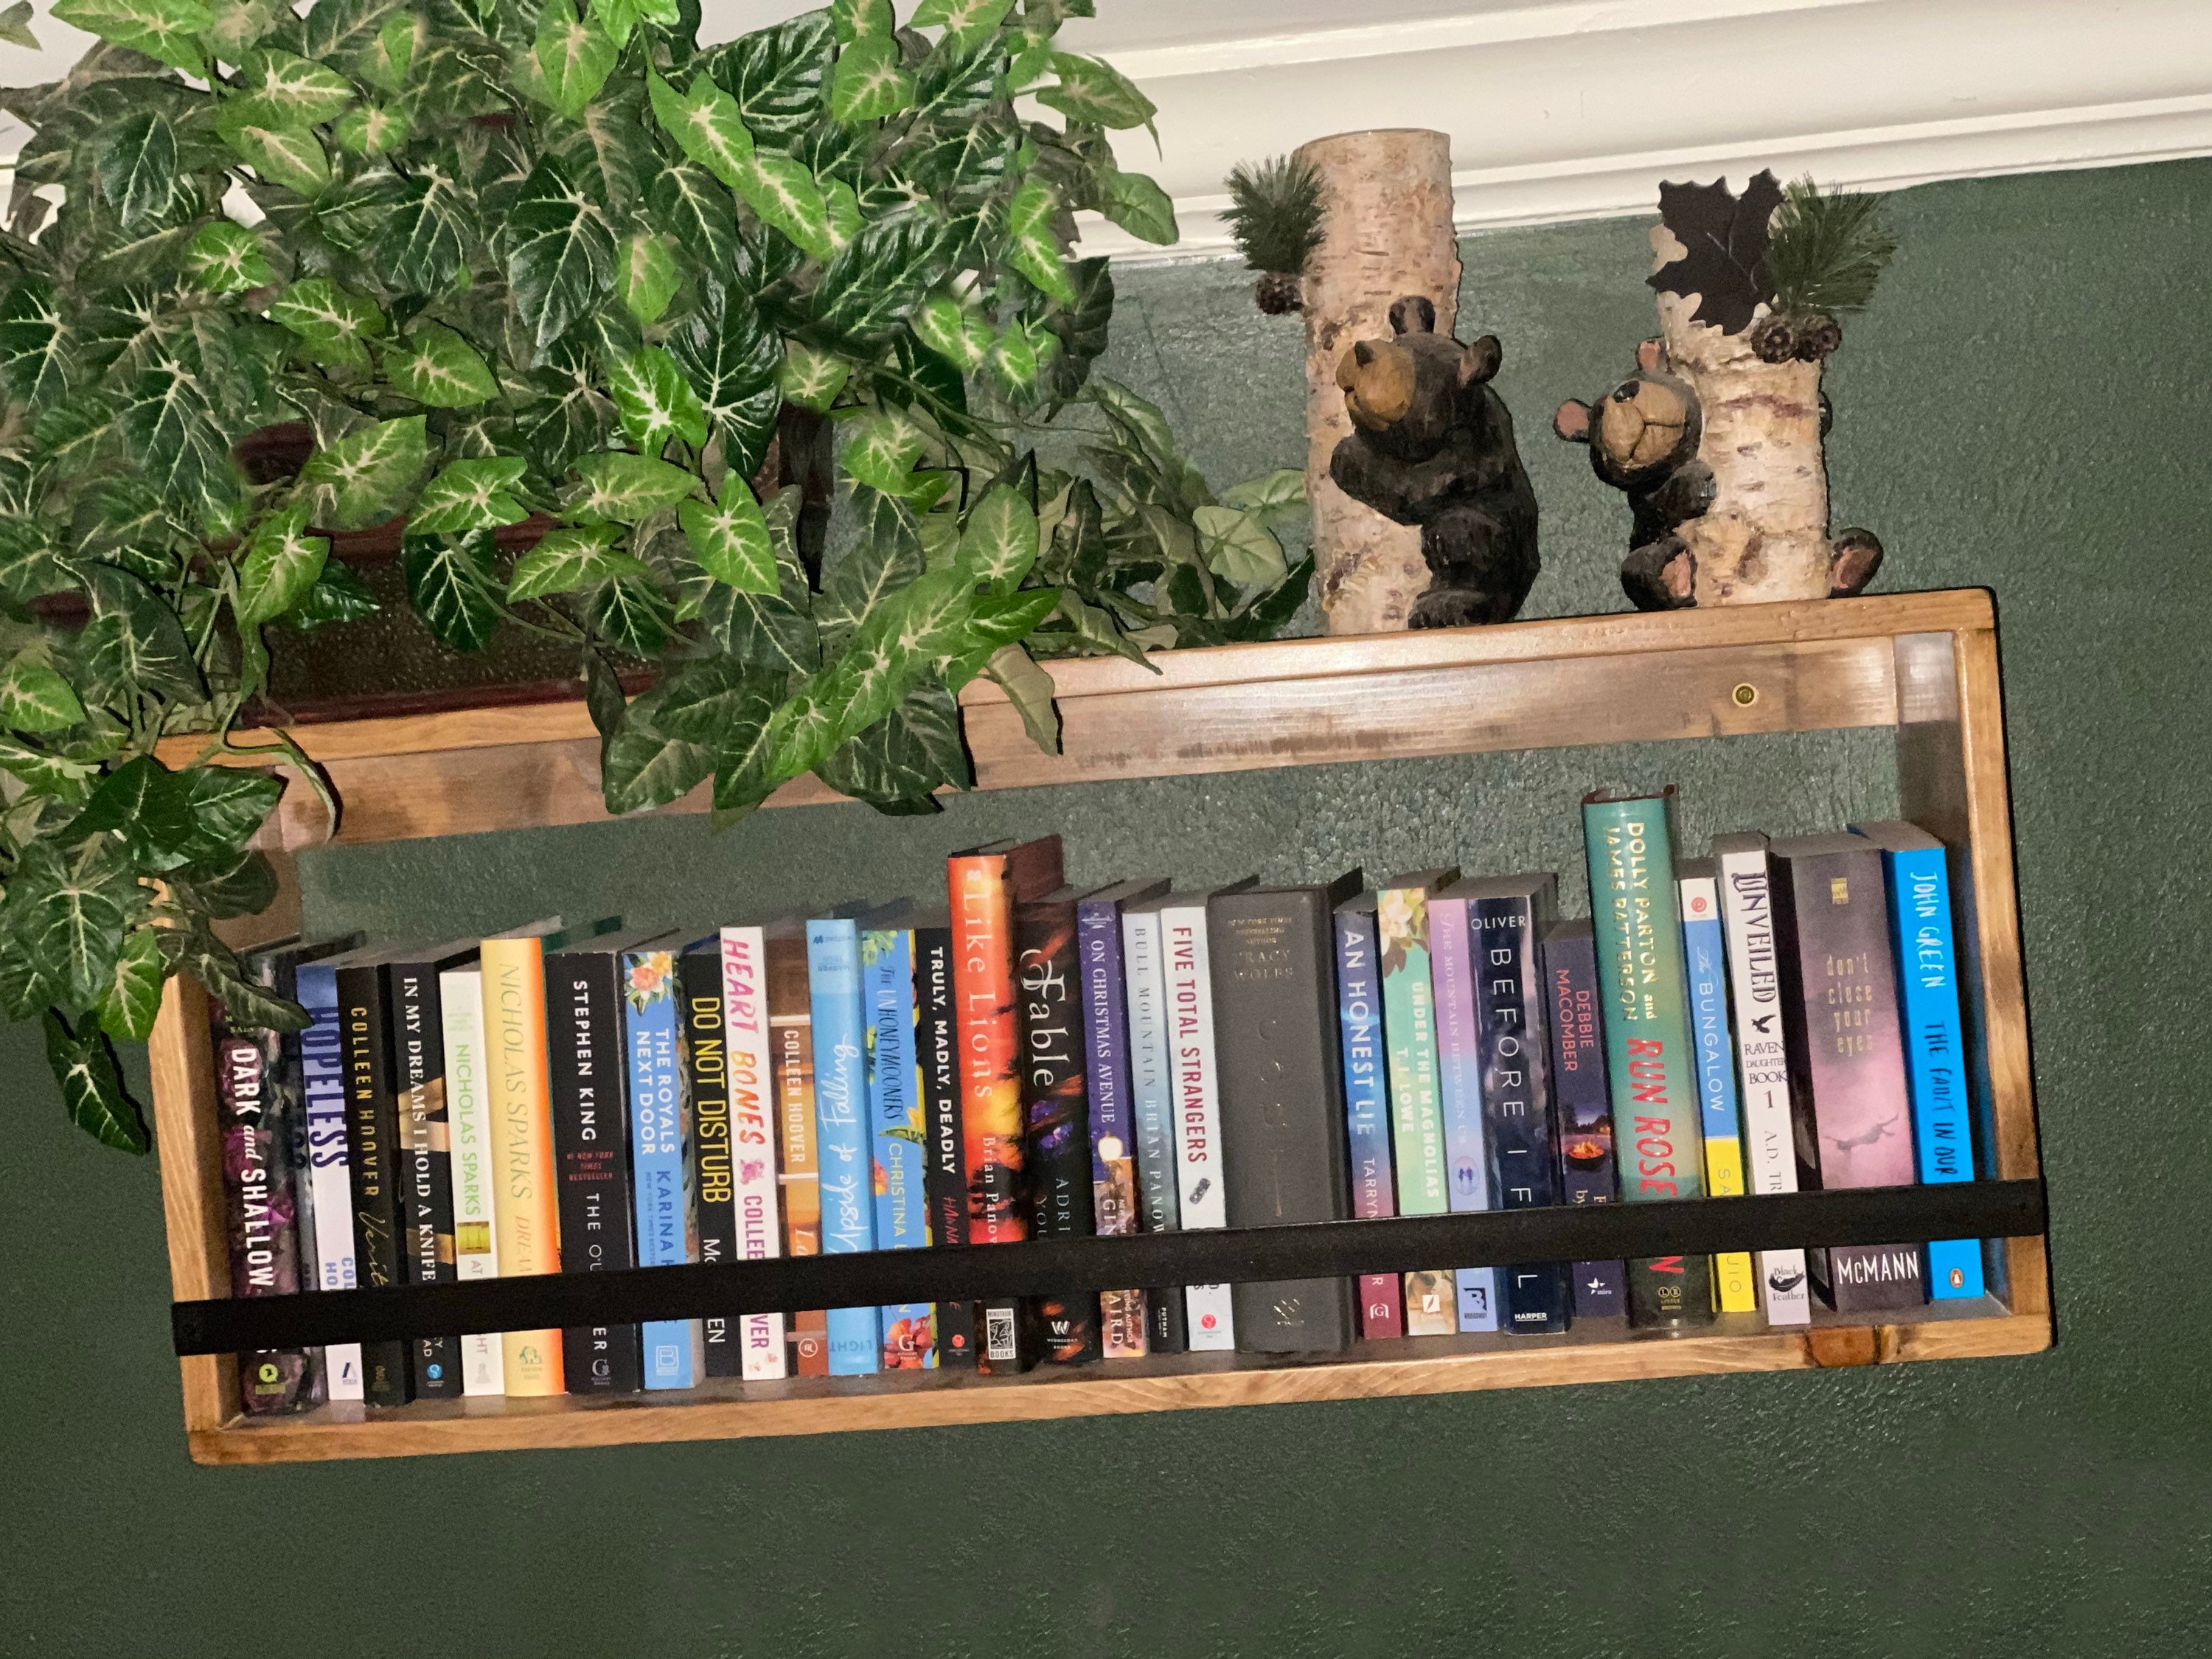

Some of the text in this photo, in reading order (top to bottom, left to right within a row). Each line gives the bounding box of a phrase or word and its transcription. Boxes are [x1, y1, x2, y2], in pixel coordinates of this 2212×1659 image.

[1091, 940, 1105, 962] ON
[1135, 928, 1148, 976] BULL
[1343, 931, 1366, 968] AN
[1471, 915, 1526, 931] OLIVER
[1604, 827, 1638, 1020] JAMES PATTERSON
[1627, 823, 1658, 1020] DOLLY PARTON and
[1731, 871, 1776, 1003] UNVEILED
[404, 978, 418, 998] IN
[964, 892, 998, 1098] Like Lions
[1444, 956, 1458, 1035] MOUNTAIN
[1826, 952, 1869, 976] don't
[1829, 981, 1873, 1005] close
[406, 1005, 420, 1033] MY
[499, 964, 526, 1093] NICHOLAS
[692, 997, 721, 1029] DO
[723, 939, 765, 1144] HEART BONES
[1020, 949, 1070, 1087] Fable
[1092, 968, 1111, 1058] CHRISTMAS
[1138, 987, 1155, 1087] MOUNTAIN
[1173, 927, 1207, 1163] FIVE TOTAL STRANGERS
[1347, 981, 1374, 1088] HONEST
[1490, 948, 1524, 1117] BEFORE
[1557, 969, 1578, 1071] MACOMBER
[1576, 990, 1594, 1048] DEBBIE
[1699, 982, 1725, 1111] BUNGALOW
[1834, 1008, 1871, 1032] your
[1837, 1034, 1872, 1057] eyes
[1910, 871, 1958, 1176] JOHN GREEN THE FAULT IN OUR
[232, 1048, 261, 1116] DARK
[301, 1006, 349, 1168] HOPELESS
[350, 1007, 372, 1099] COLLEEN
[408, 1040, 427, 1122] DREAMS
[574, 981, 597, 1141] STEPHEN KING
[695, 1039, 725, 1088] NOT
[820, 1033, 860, 1133] Falling
[877, 990, 903, 1121] UNHONEYMOONERS
[931, 946, 956, 1174] TRULY, MADLY, DEADLY
[1450, 1042, 1465, 1119] BETWEEN
[1749, 1071, 1788, 1085] BOOK
[456, 1044, 476, 1145] NICHOLAS
[636, 1031, 656, 1155] NEXT DOOR
[655, 1028, 675, 1153] THE ROYALS
[784, 1030, 806, 1163] COLLEEN HOOVER
[1099, 1063, 1115, 1123] AVENUE
[1355, 1100, 1375, 1135] LIE
[1399, 1084, 1414, 1132] LOWE
[1412, 982, 1439, 1197] UNDER THE MAGNOLIAS
[1626, 1037, 1677, 1197] RUN ROSE
[1764, 1090, 1773, 1108] 1
[243, 1125, 263, 1161] and
[507, 1102, 532, 1200] SPARKS
[698, 1100, 731, 1203] DISTURB
[829, 1144, 857, 1162] of
[983, 1137, 996, 1183] Brian
[1144, 1100, 1161, 1158] BRIAN
[1457, 1125, 1467, 1144] US
[414, 1143, 431, 1197] HOLD
[462, 1152, 481, 1216] SPARKS
[888, 1143, 906, 1237] CHRISTINA
[240, 1169, 275, 1287] SHALLOW
[418, 1204, 432, 1217] A
[586, 1192, 601, 1231] THE
[656, 1170, 675, 1251] KARINA
[358, 1211, 389, 1288] Verit
[419, 1224, 437, 1281] KNIFE
[471, 1260, 483, 1275] AT
[1727, 1255, 1742, 1293] JIO
[1774, 1264, 1798, 1275] Black
[1837, 1251, 1919, 1285] McMANN
[1109, 1295, 1123, 1344] AIRD
[1773, 1290, 1804, 1301] Feather
[829, 1340, 872, 1352] LIGHT
[990, 1349, 1014, 1358] BOOKS
